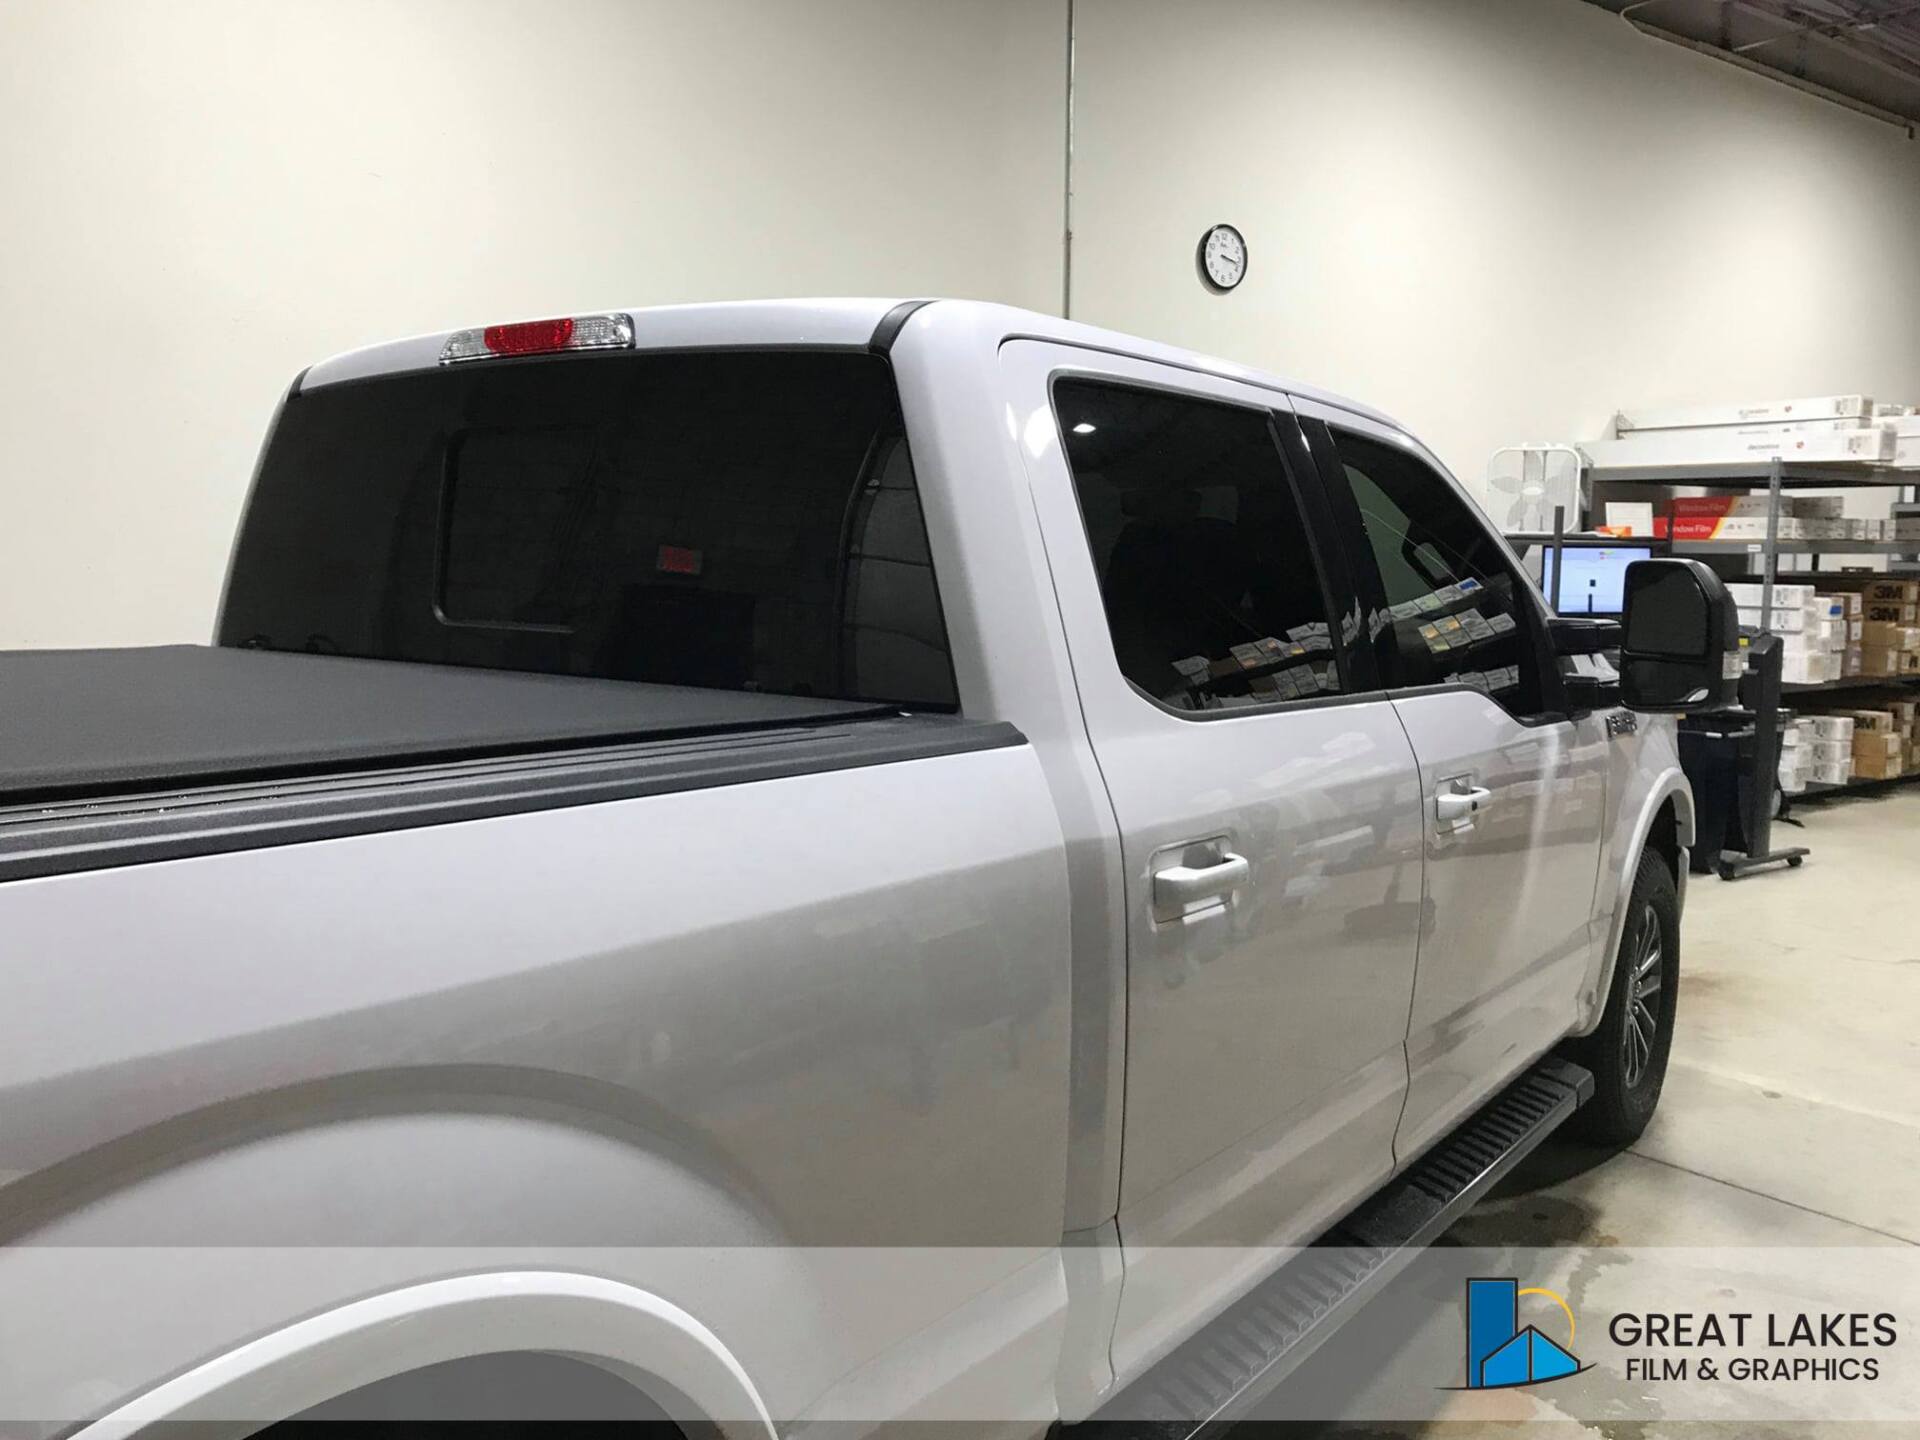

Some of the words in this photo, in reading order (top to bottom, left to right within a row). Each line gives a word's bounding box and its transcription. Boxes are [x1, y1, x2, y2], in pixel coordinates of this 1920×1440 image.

[1695, 524, 1712, 532] Film
[1873, 585, 1903, 600] 3M
[1869, 607, 1900, 622] 3M
